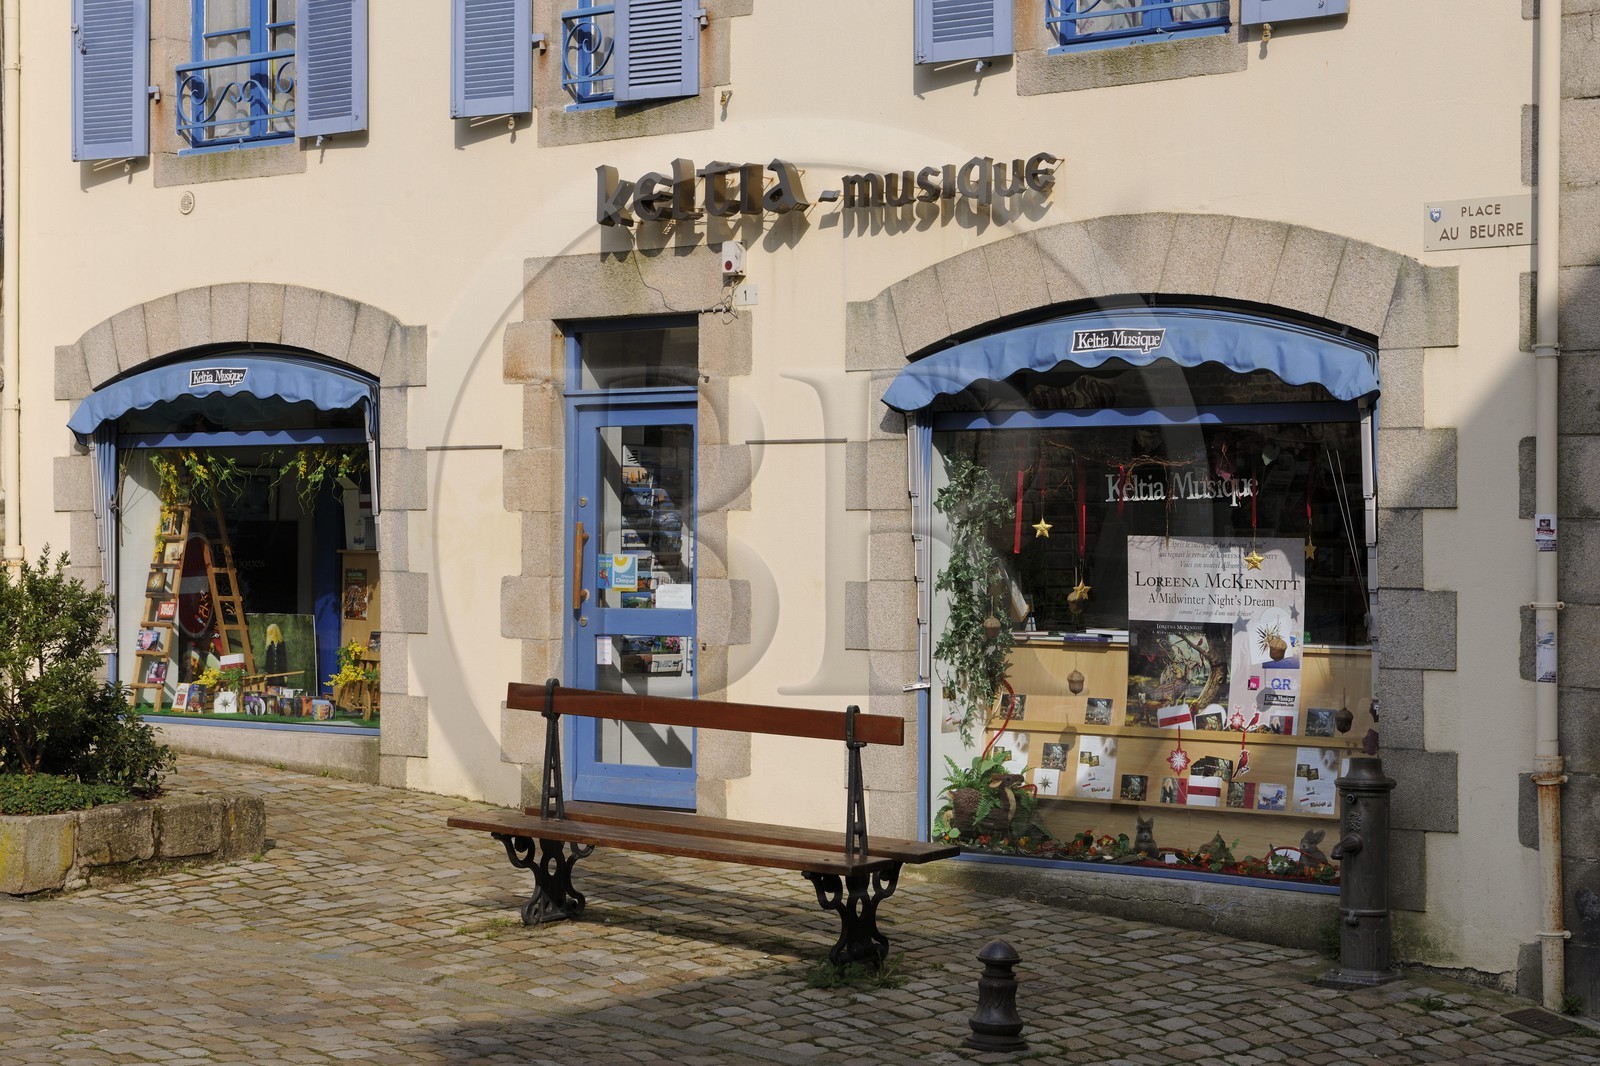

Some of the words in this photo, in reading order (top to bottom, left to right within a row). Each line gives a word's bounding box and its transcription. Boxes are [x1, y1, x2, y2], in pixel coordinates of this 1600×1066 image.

[596, 157, 811, 228] keltia
[1461, 204, 1502, 218] PLACE
[1439, 226, 1460, 241] AU
[1469, 222, 1524, 240] BEURRE
[1076, 332, 1110, 349] Keltia
[1110, 330, 1161, 352] Musique
[192, 370, 214, 385] Keltia
[214, 369, 244, 386] Musique
[1104, 472, 1167, 503] Keltia
[1171, 470, 1260, 508] Musique
[1135, 571, 1200, 588] LOREENA
[1204, 572, 1301, 591] McKENNITT
[1148, 593, 1156, 604] A
[1158, 592, 1206, 605] Midwinter
[1208, 593, 1242, 609] Night's
[1243, 595, 1275, 607] Dream
